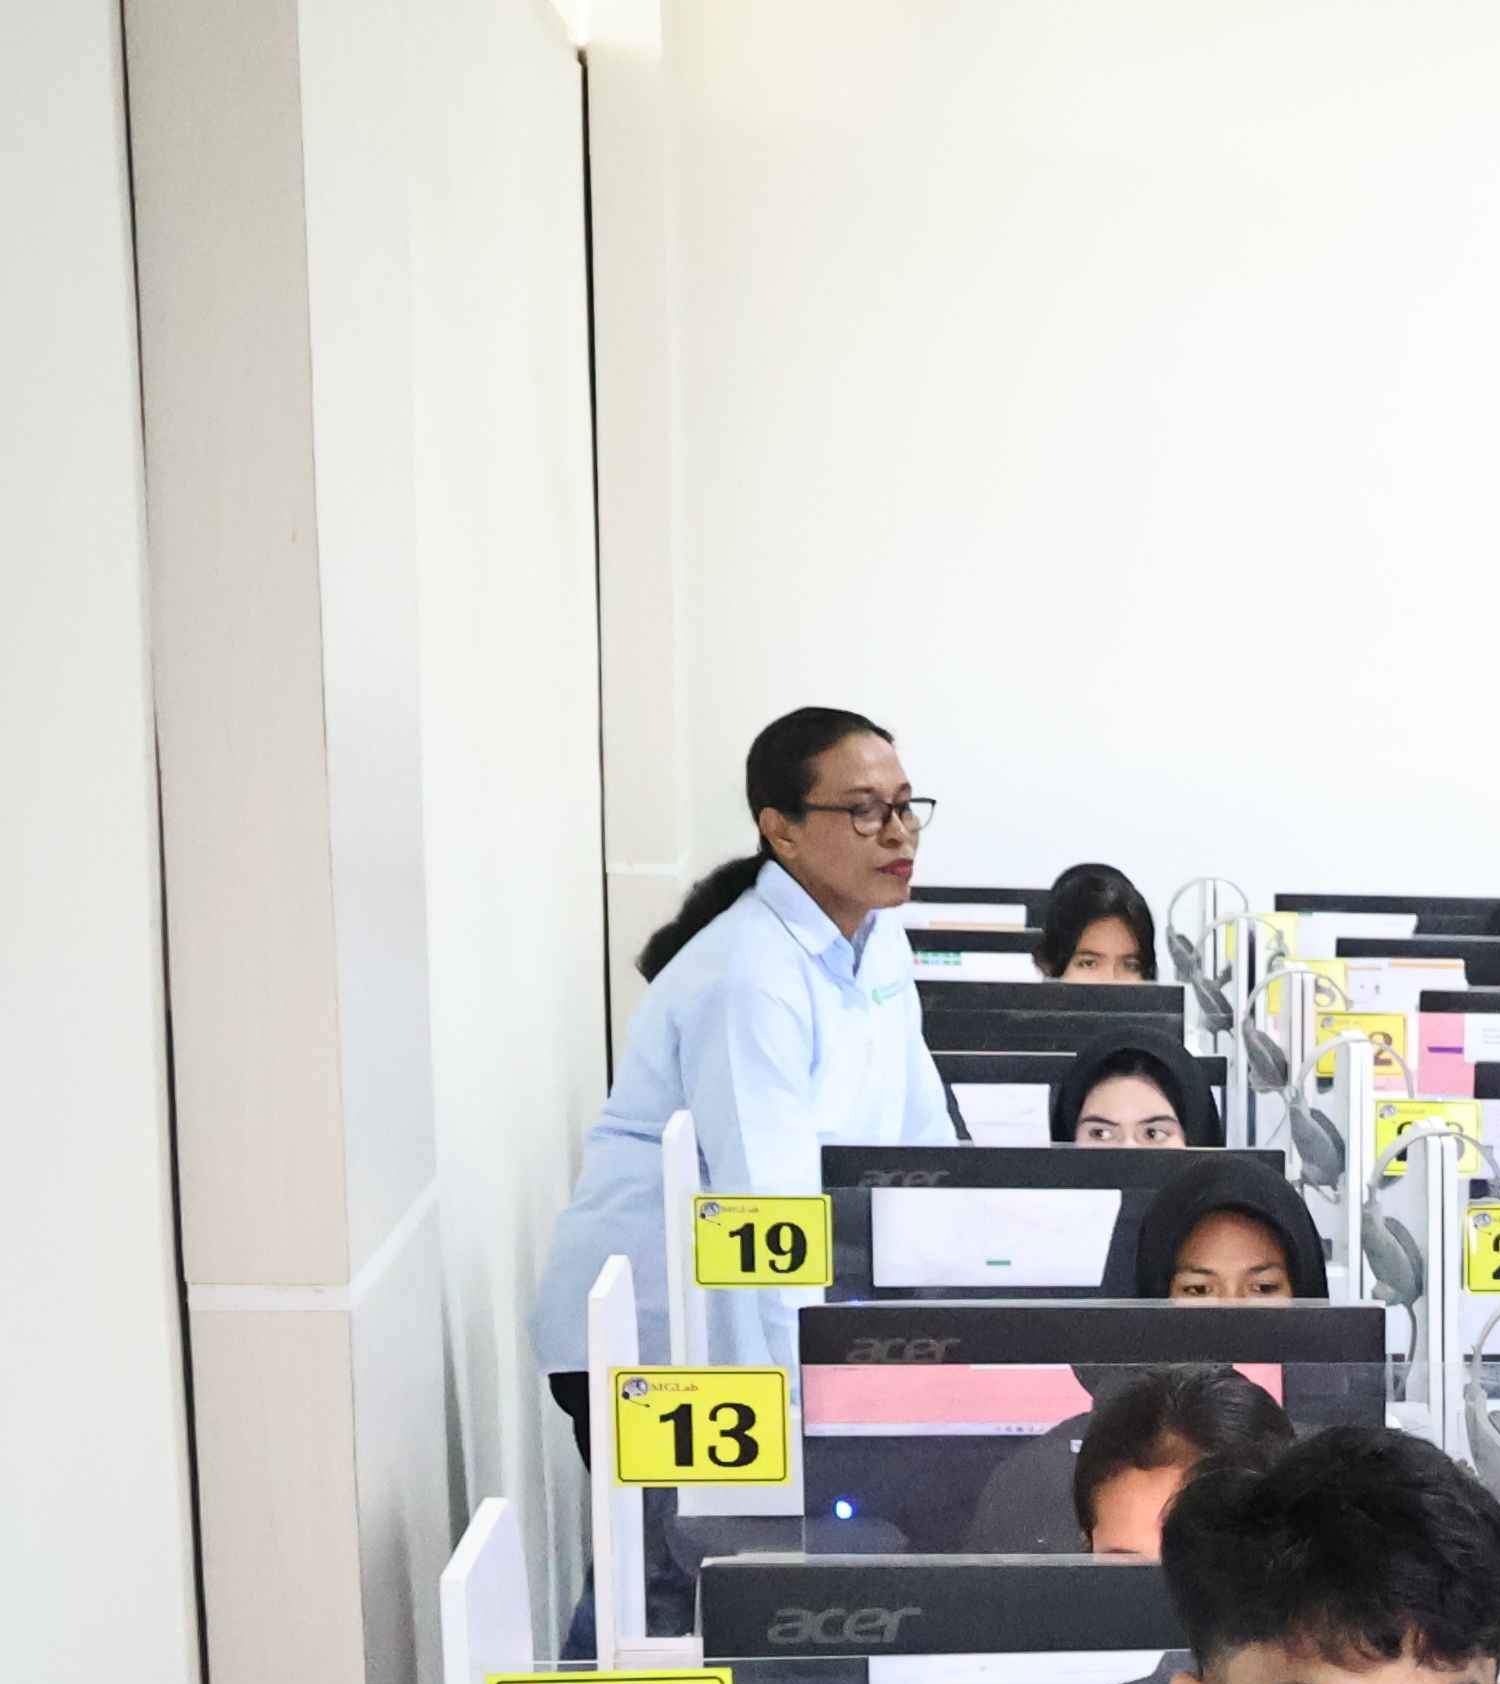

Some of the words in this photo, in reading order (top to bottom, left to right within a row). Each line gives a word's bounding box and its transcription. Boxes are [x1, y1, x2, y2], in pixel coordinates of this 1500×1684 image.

[728, 1221, 807, 1274] 19
[846, 1337, 961, 1363] acer
[658, 1401, 761, 1469] 13
[766, 1606, 922, 1645] acer
